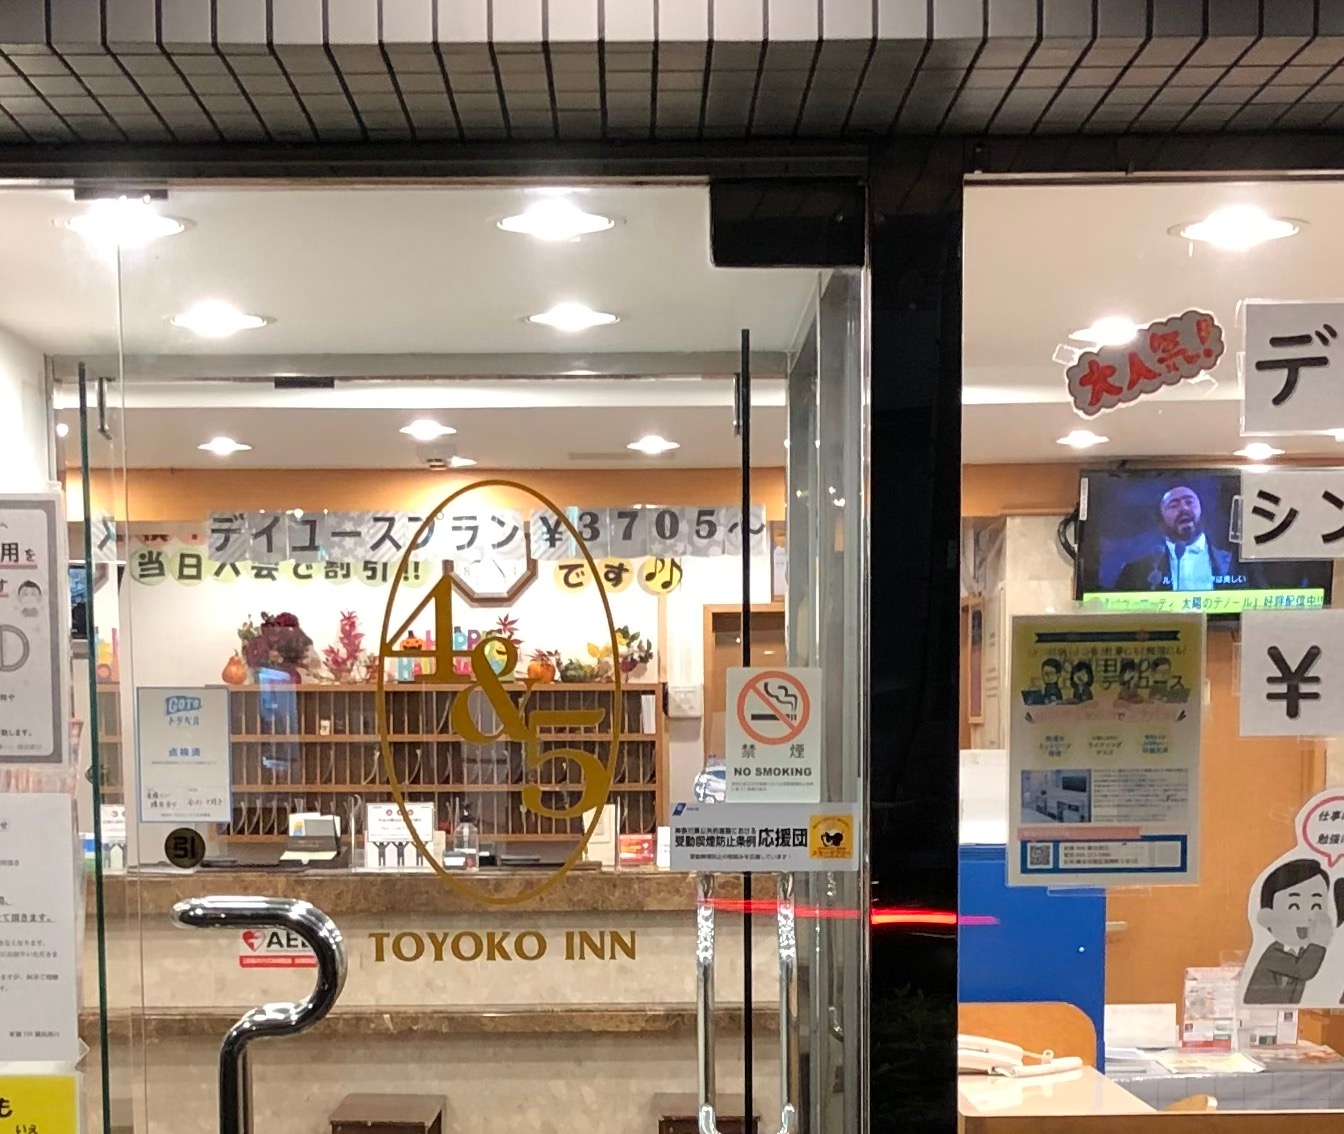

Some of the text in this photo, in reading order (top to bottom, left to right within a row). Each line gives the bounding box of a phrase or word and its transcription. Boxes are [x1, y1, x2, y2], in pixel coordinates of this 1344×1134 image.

[734, 767, 812, 776] NO SMOKING
[758, 828, 808, 848] 応援団
[266, 931, 312, 948] AE
[367, 930, 638, 963] TOYOKO INN
